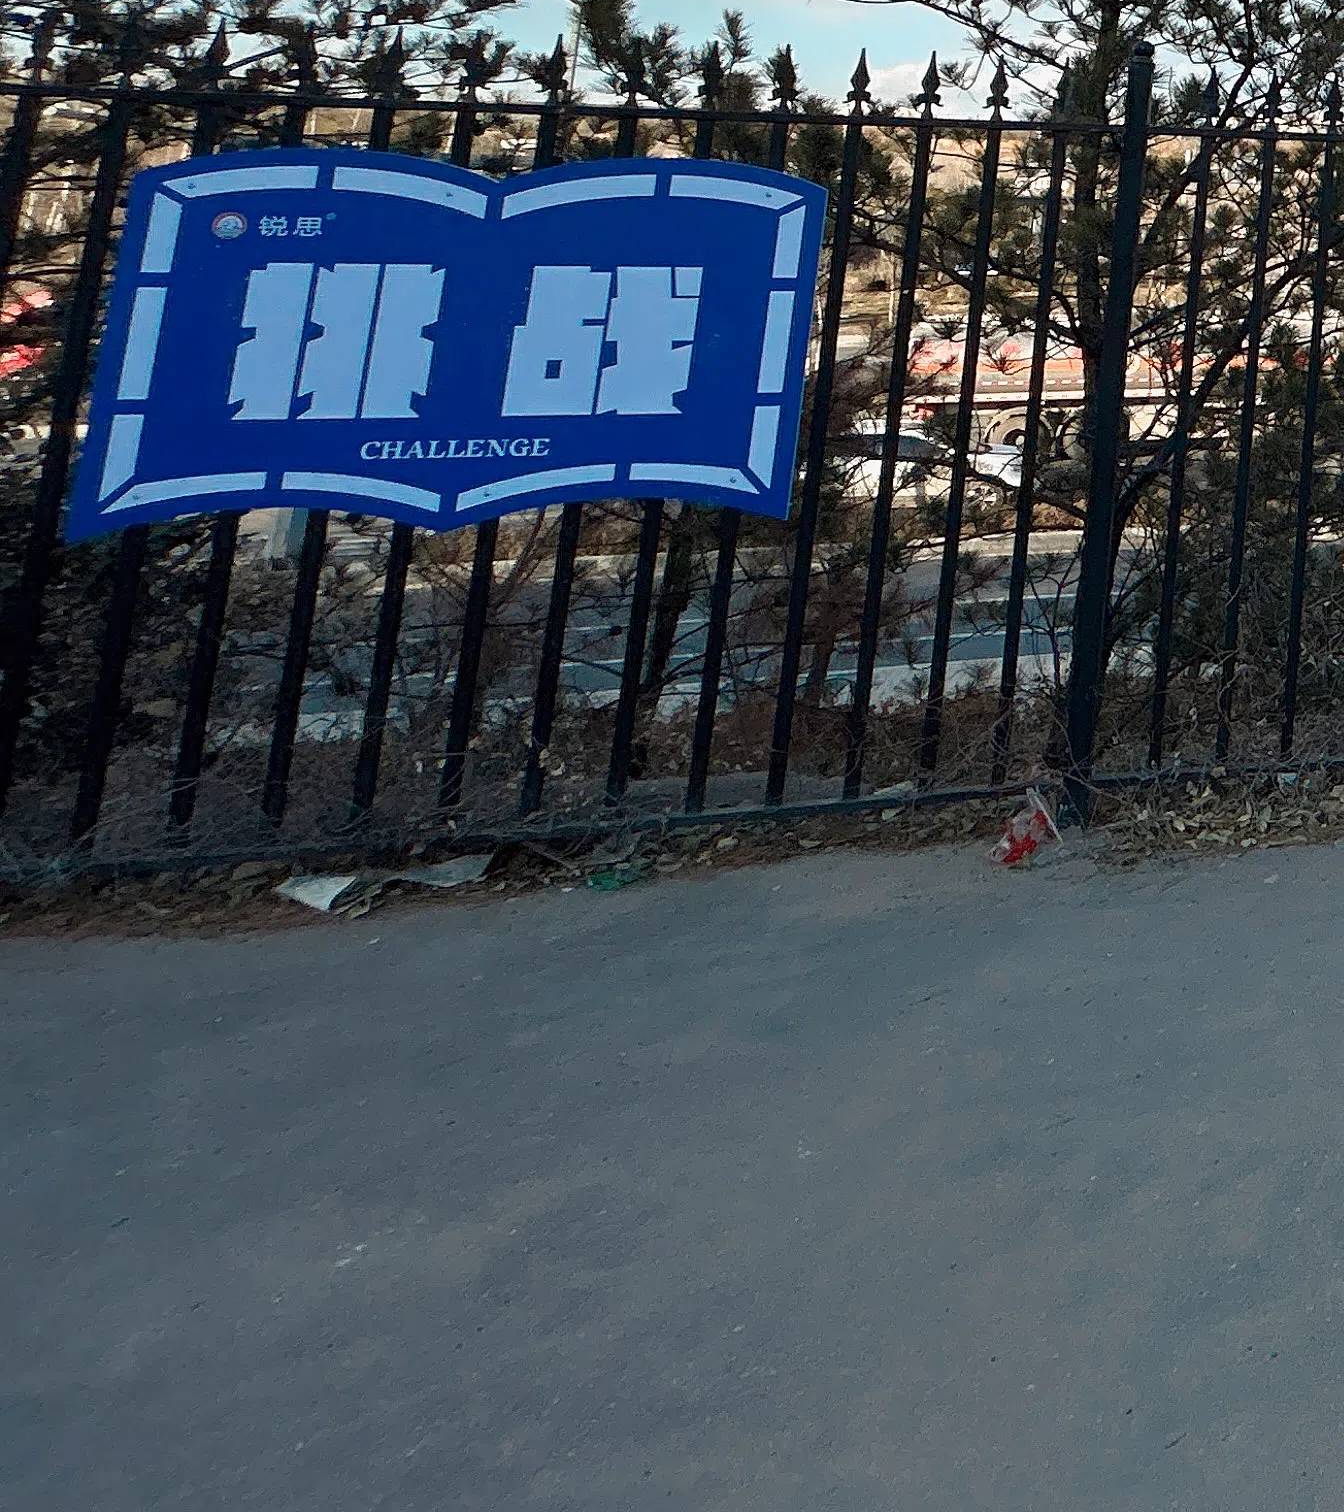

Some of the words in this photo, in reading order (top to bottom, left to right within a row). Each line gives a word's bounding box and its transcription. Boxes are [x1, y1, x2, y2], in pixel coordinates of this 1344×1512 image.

[258, 215, 324, 237] 锐思
[227, 262, 703, 420] 挑战
[361, 438, 551, 460] CHALLENGE
